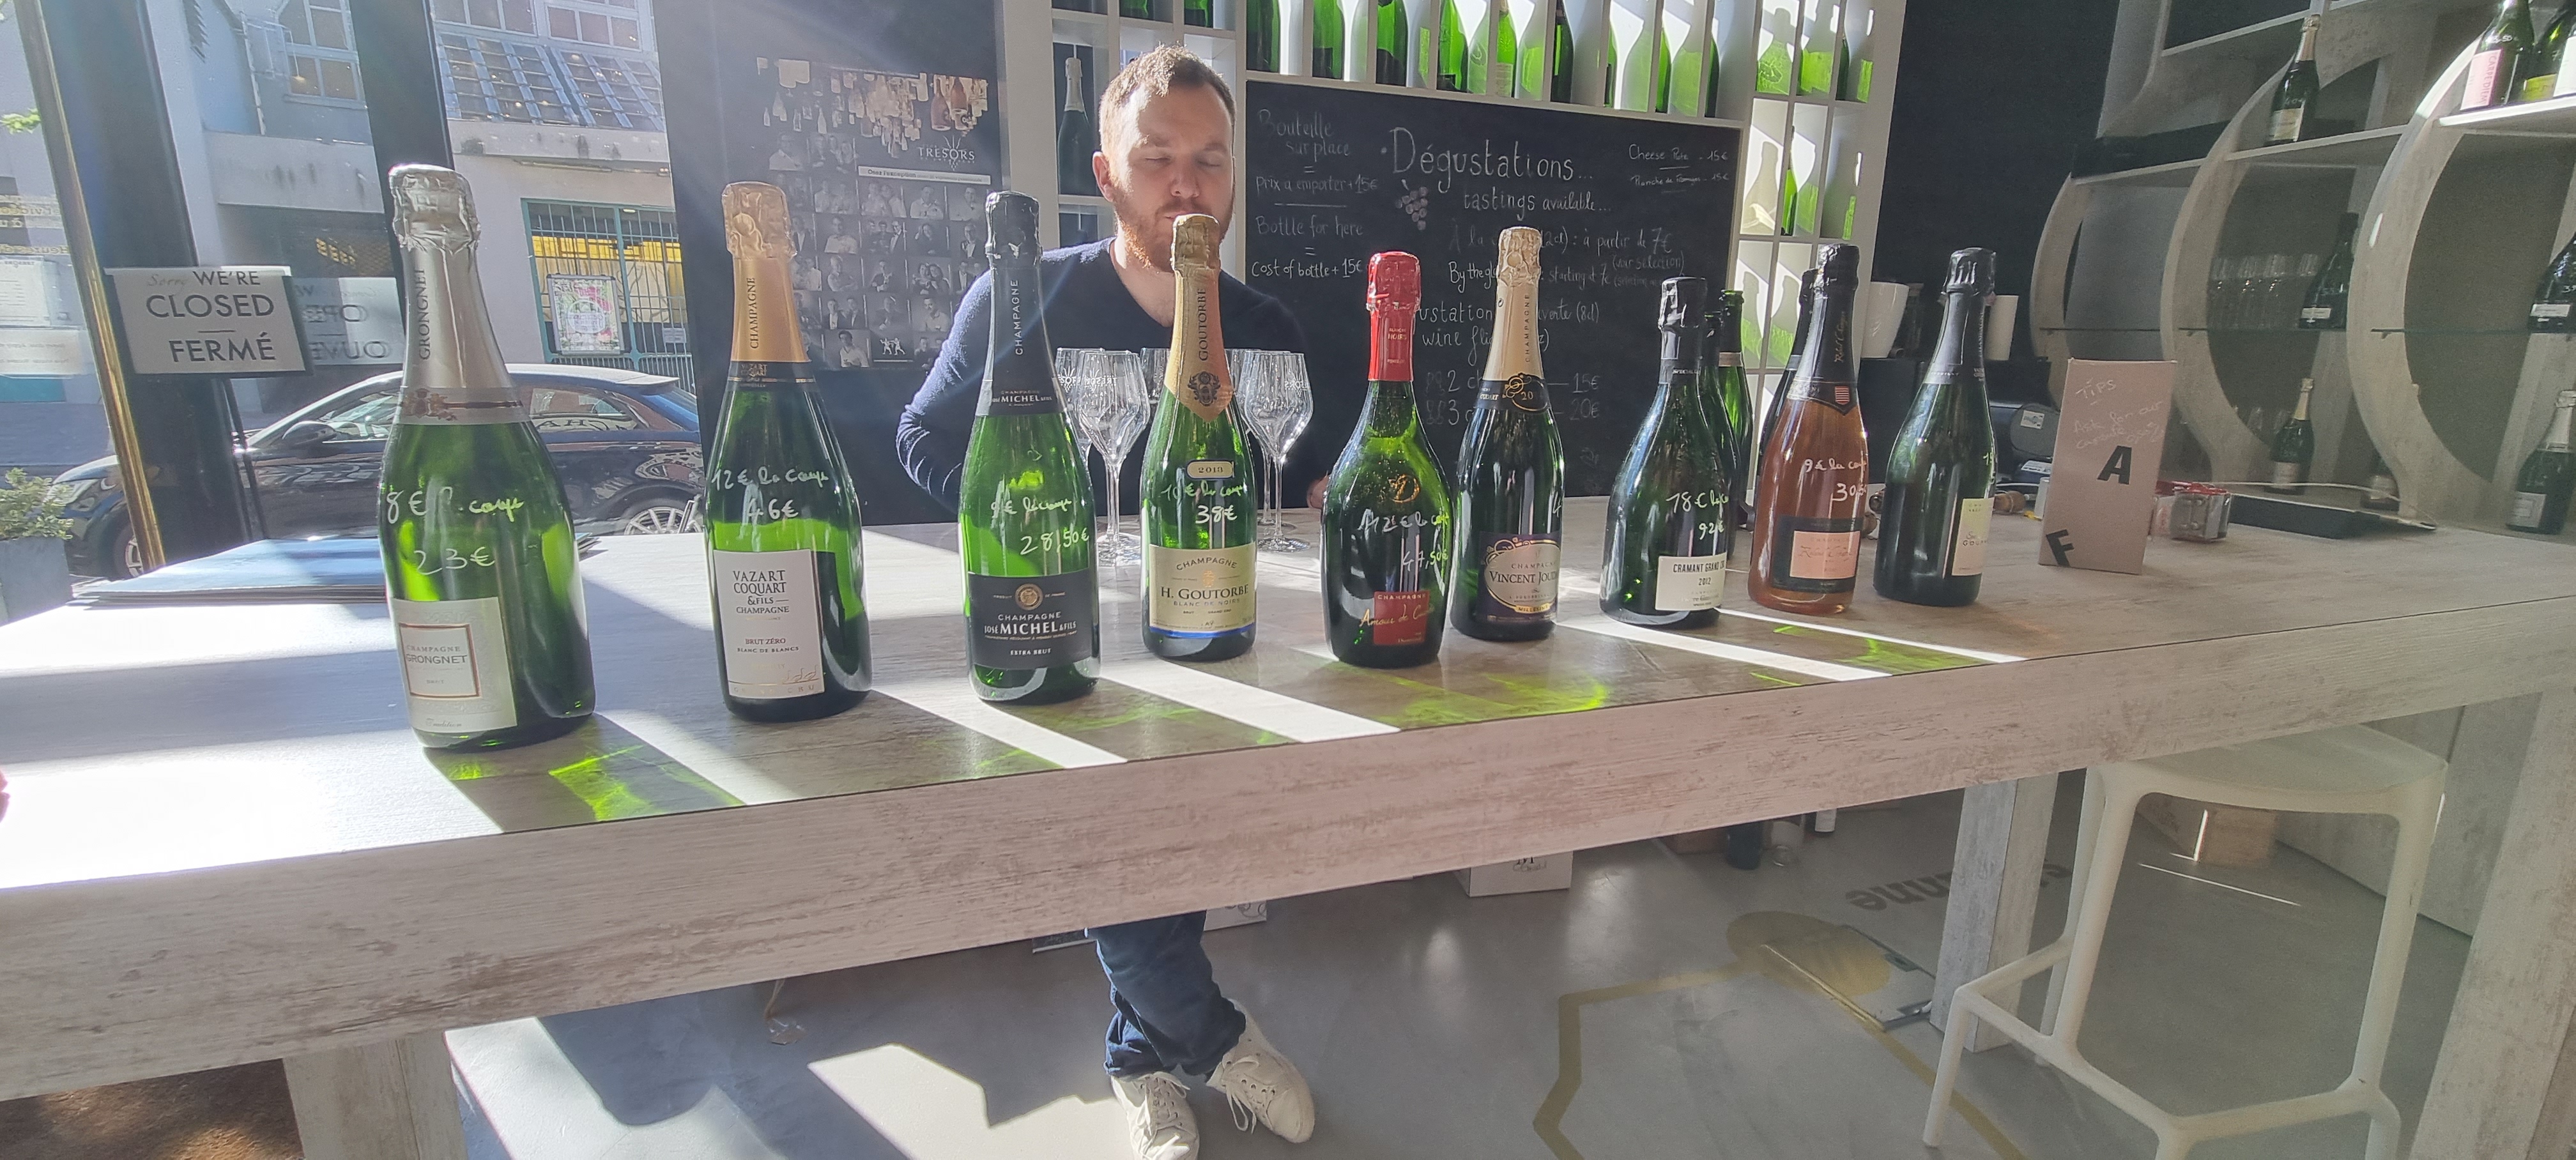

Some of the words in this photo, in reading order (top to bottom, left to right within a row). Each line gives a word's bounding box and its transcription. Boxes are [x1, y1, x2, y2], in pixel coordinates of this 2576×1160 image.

[1314, 139, 1351, 162] place
[1629, 144, 1666, 160] Cheese
[1464, 186, 1536, 222] tastings
[1255, 215, 1305, 236] Bottle
[1310, 214, 1328, 238] for
[1335, 215, 1363, 238] here
[1597, 230, 1630, 257] partir
[192, 270, 261, 286] WE'RE
[1283, 258, 1296, 279] of
[1298, 262, 1330, 279] bottle
[1448, 261, 1466, 294] By
[1467, 263, 1485, 280] the
[146, 294, 275, 318] CLOSED
[418, 268, 431, 361] GRONGNET
[746, 277, 760, 349] CHAMPAGNE
[1010, 279, 1025, 356] CHAMPAGNE
[1196, 287, 1209, 362] GOUTORBE
[1422, 328, 1462, 347] wine
[169, 332, 276, 363] FERMÉ
[1447, 369, 1460, 393] 2
[1000, 395, 1040, 403] MICHEL
[1448, 399, 1460, 426] 3
[2097, 445, 2133, 485] A
[2046, 529, 2075, 567] F
[1176, 556, 1238, 571] CHAMPAGNE
[1673, 563, 1704, 573] CRAMANT
[1705, 561, 1719, 572] GRAND
[733, 570, 786, 582] VAZART
[1489, 570, 1536, 584] VINCENT
[1698, 577, 1712, 586] 2012
[733, 582, 787, 597] COQUART
[1160, 586, 1174, 599] H.
[1177, 584, 1249, 600] GOUTORBE
[1218, 598, 1240, 606] NOIRS
[997, 611, 1062, 622] CHAMPAGNE
[984, 625, 999, 634] JOSÉ
[999, 620, 1059, 636] MICHEL
[407, 645, 461, 653] CHAMPAGNE
[765, 637, 786, 645] ZÉRO
[406, 653, 468, 664] GRONGNET
